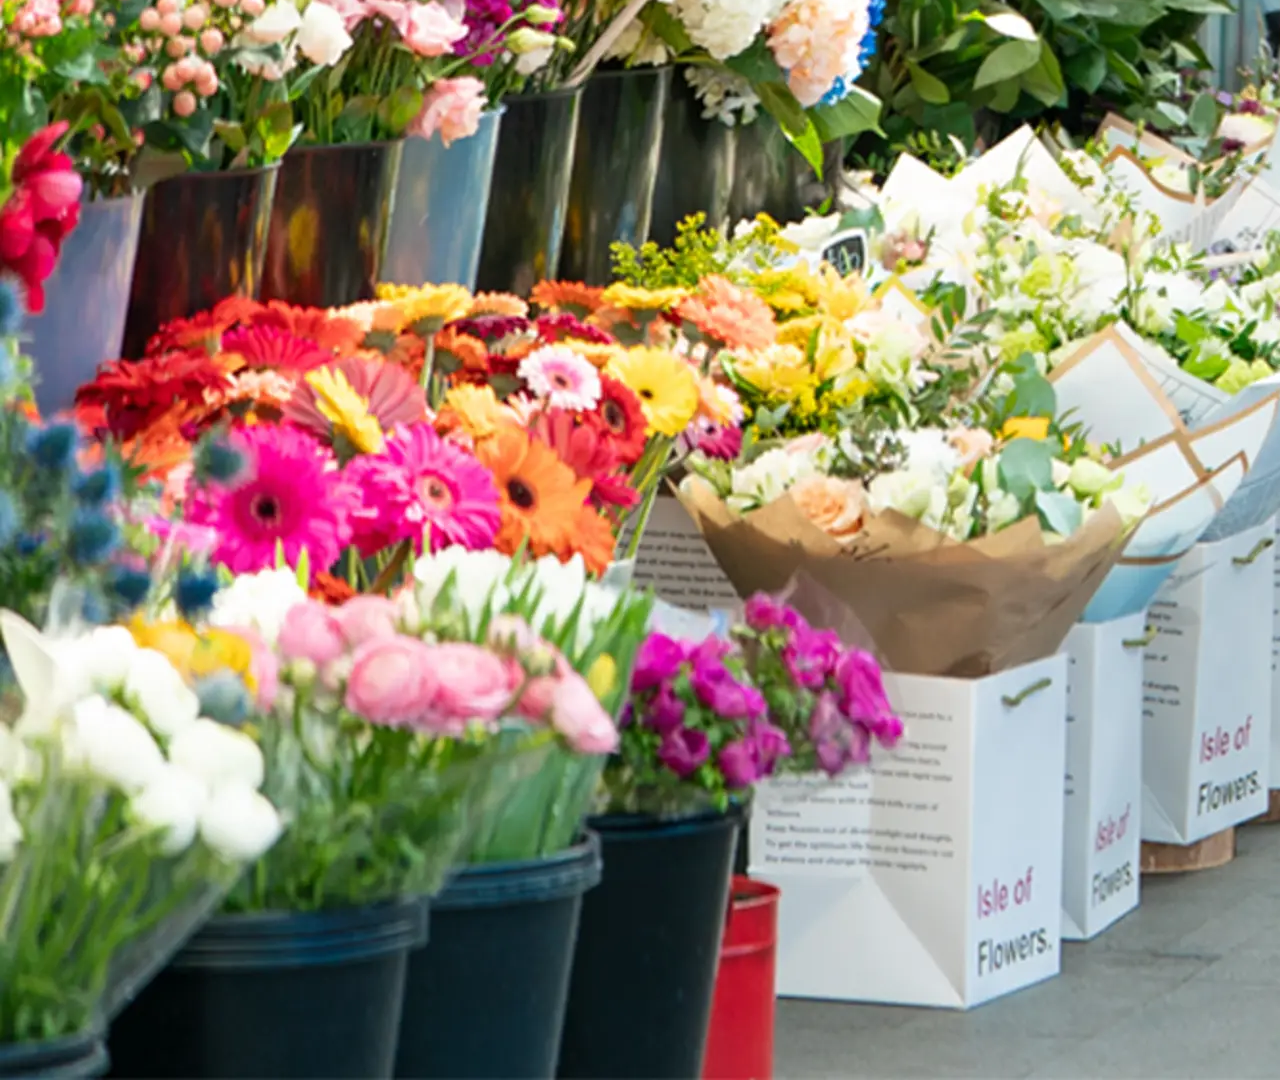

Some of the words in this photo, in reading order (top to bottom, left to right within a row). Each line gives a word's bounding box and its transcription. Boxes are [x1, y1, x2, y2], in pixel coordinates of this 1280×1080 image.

[1200, 726, 1230, 764] Isle
[1233, 714, 1252, 750] of
[977, 877, 1009, 920] Isle
[1013, 865, 1033, 905] of
[977, 926, 1053, 978] Flowers.
